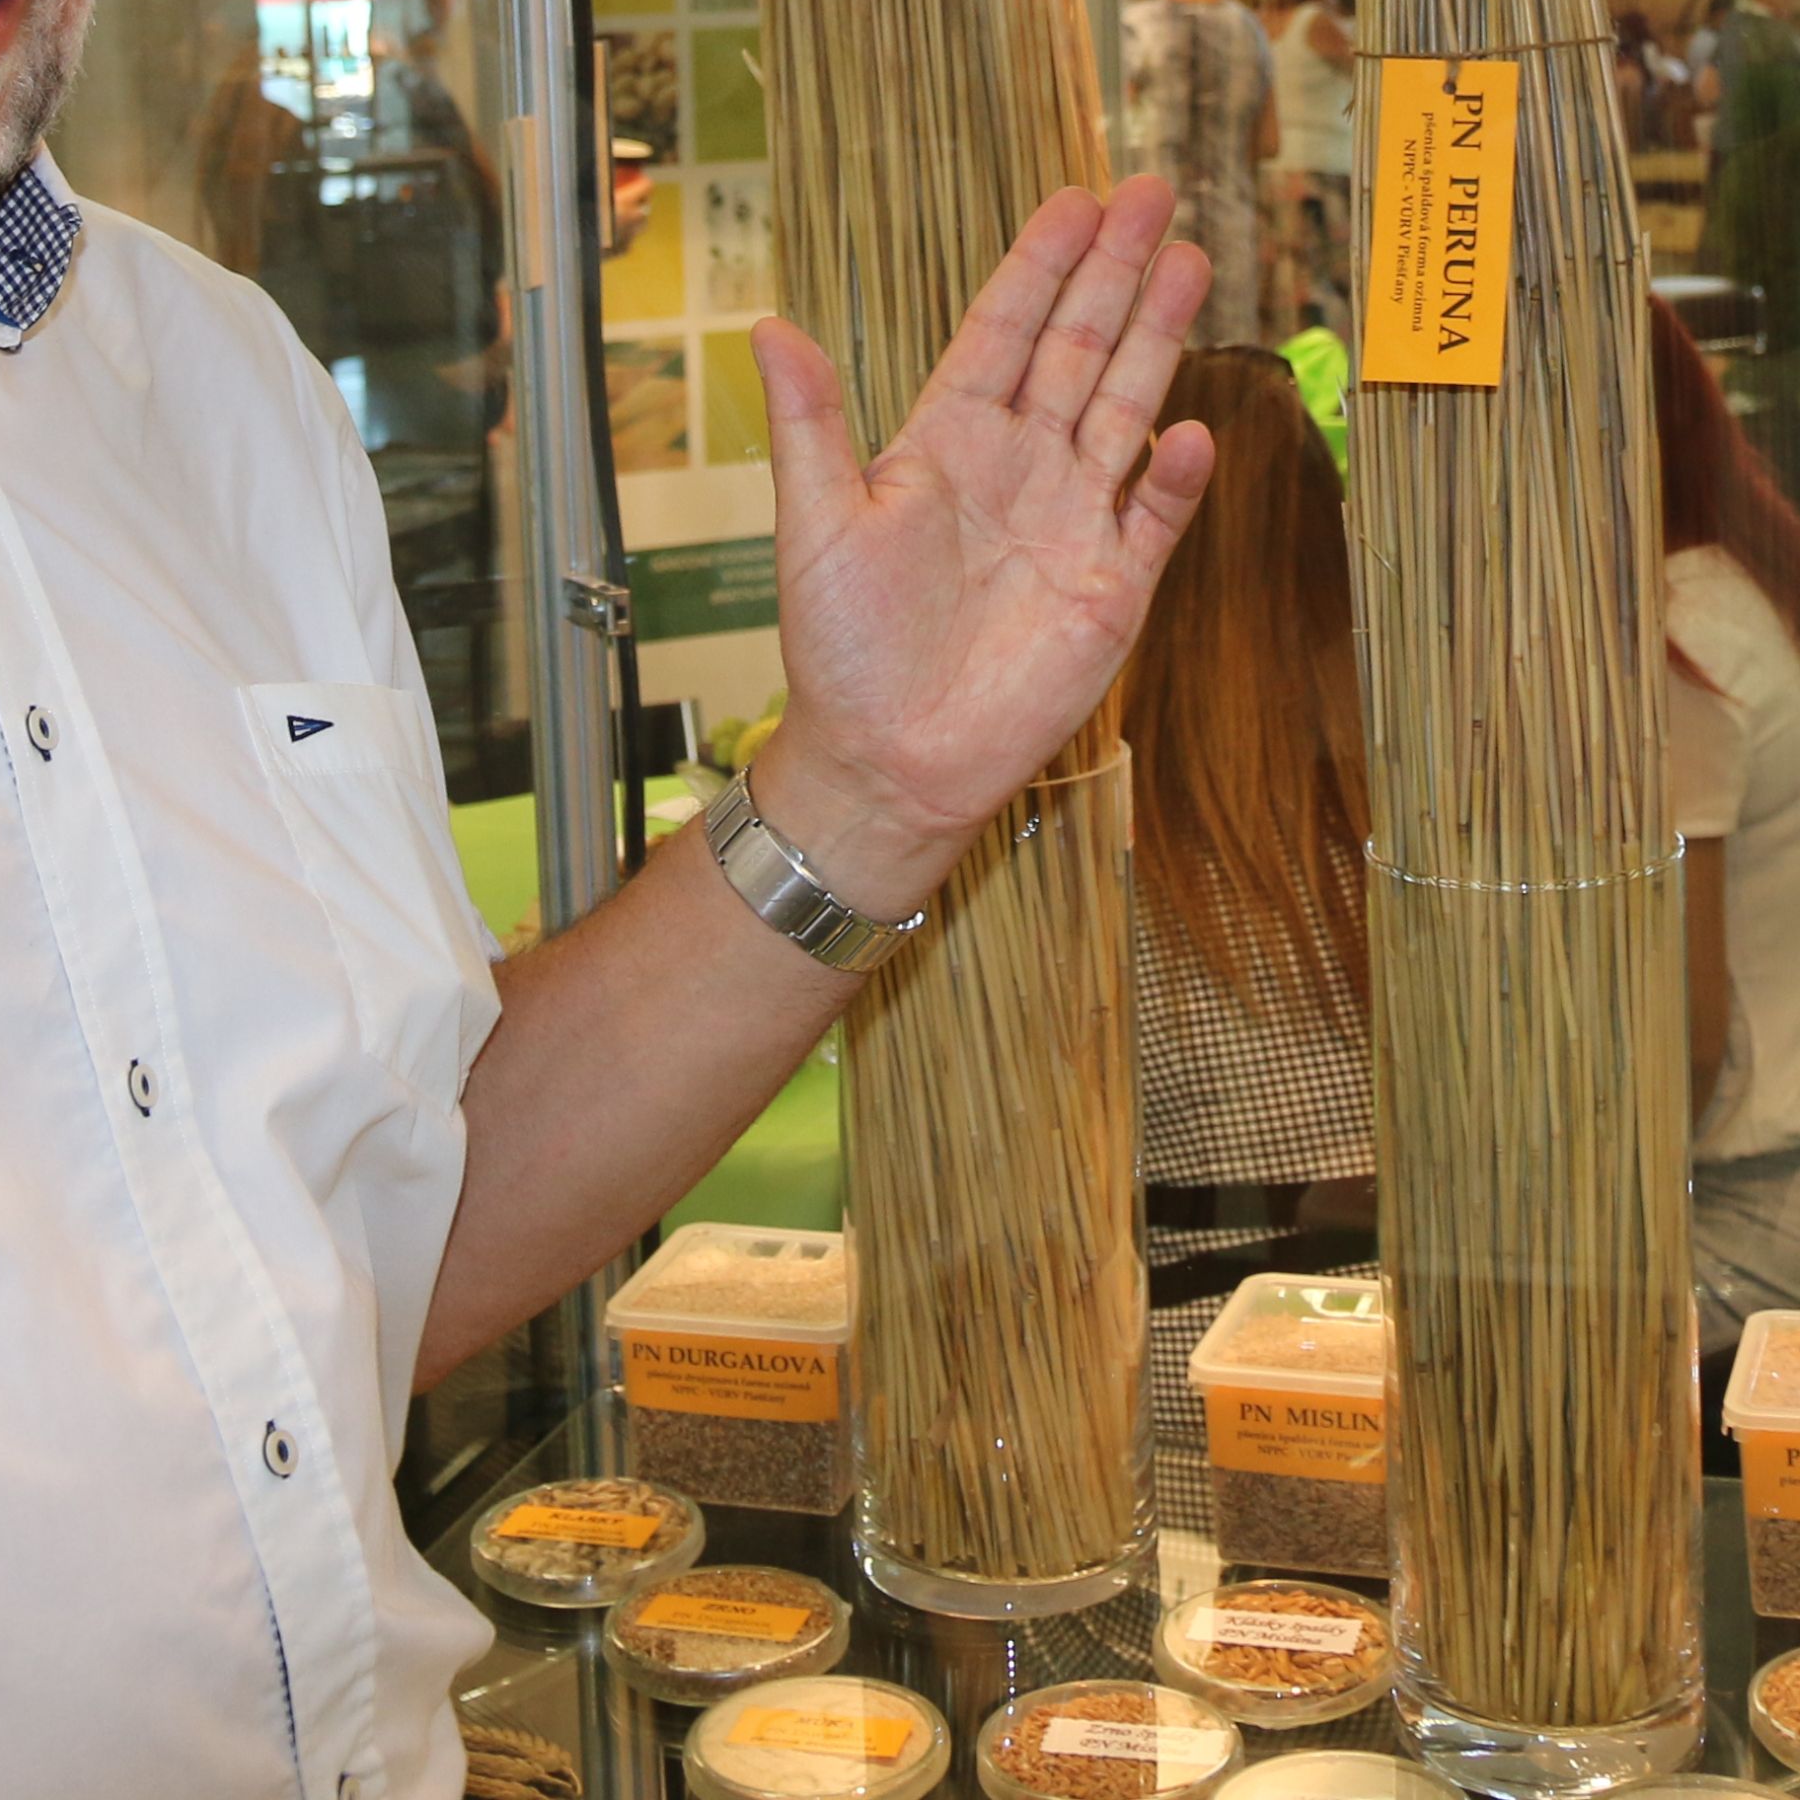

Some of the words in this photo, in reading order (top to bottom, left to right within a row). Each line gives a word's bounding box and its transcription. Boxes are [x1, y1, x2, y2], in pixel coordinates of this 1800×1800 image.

[1421, 111, 1436, 166] pšenica
[1450, 92, 1484, 152] PN
[1402, 138, 1417, 182] NPPC
[1398, 194, 1416, 241] VÚRV
[1418, 169, 1433, 231] špaldová
[1416, 235, 1431, 278] forma
[1438, 175, 1481, 354] PERUNA
[632, 1342, 661, 1362] PN
[669, 1347, 826, 1375] DURGALOVA
[1240, 1403, 1272, 1424] PN
[1287, 1407, 1380, 1432] MISLIN
